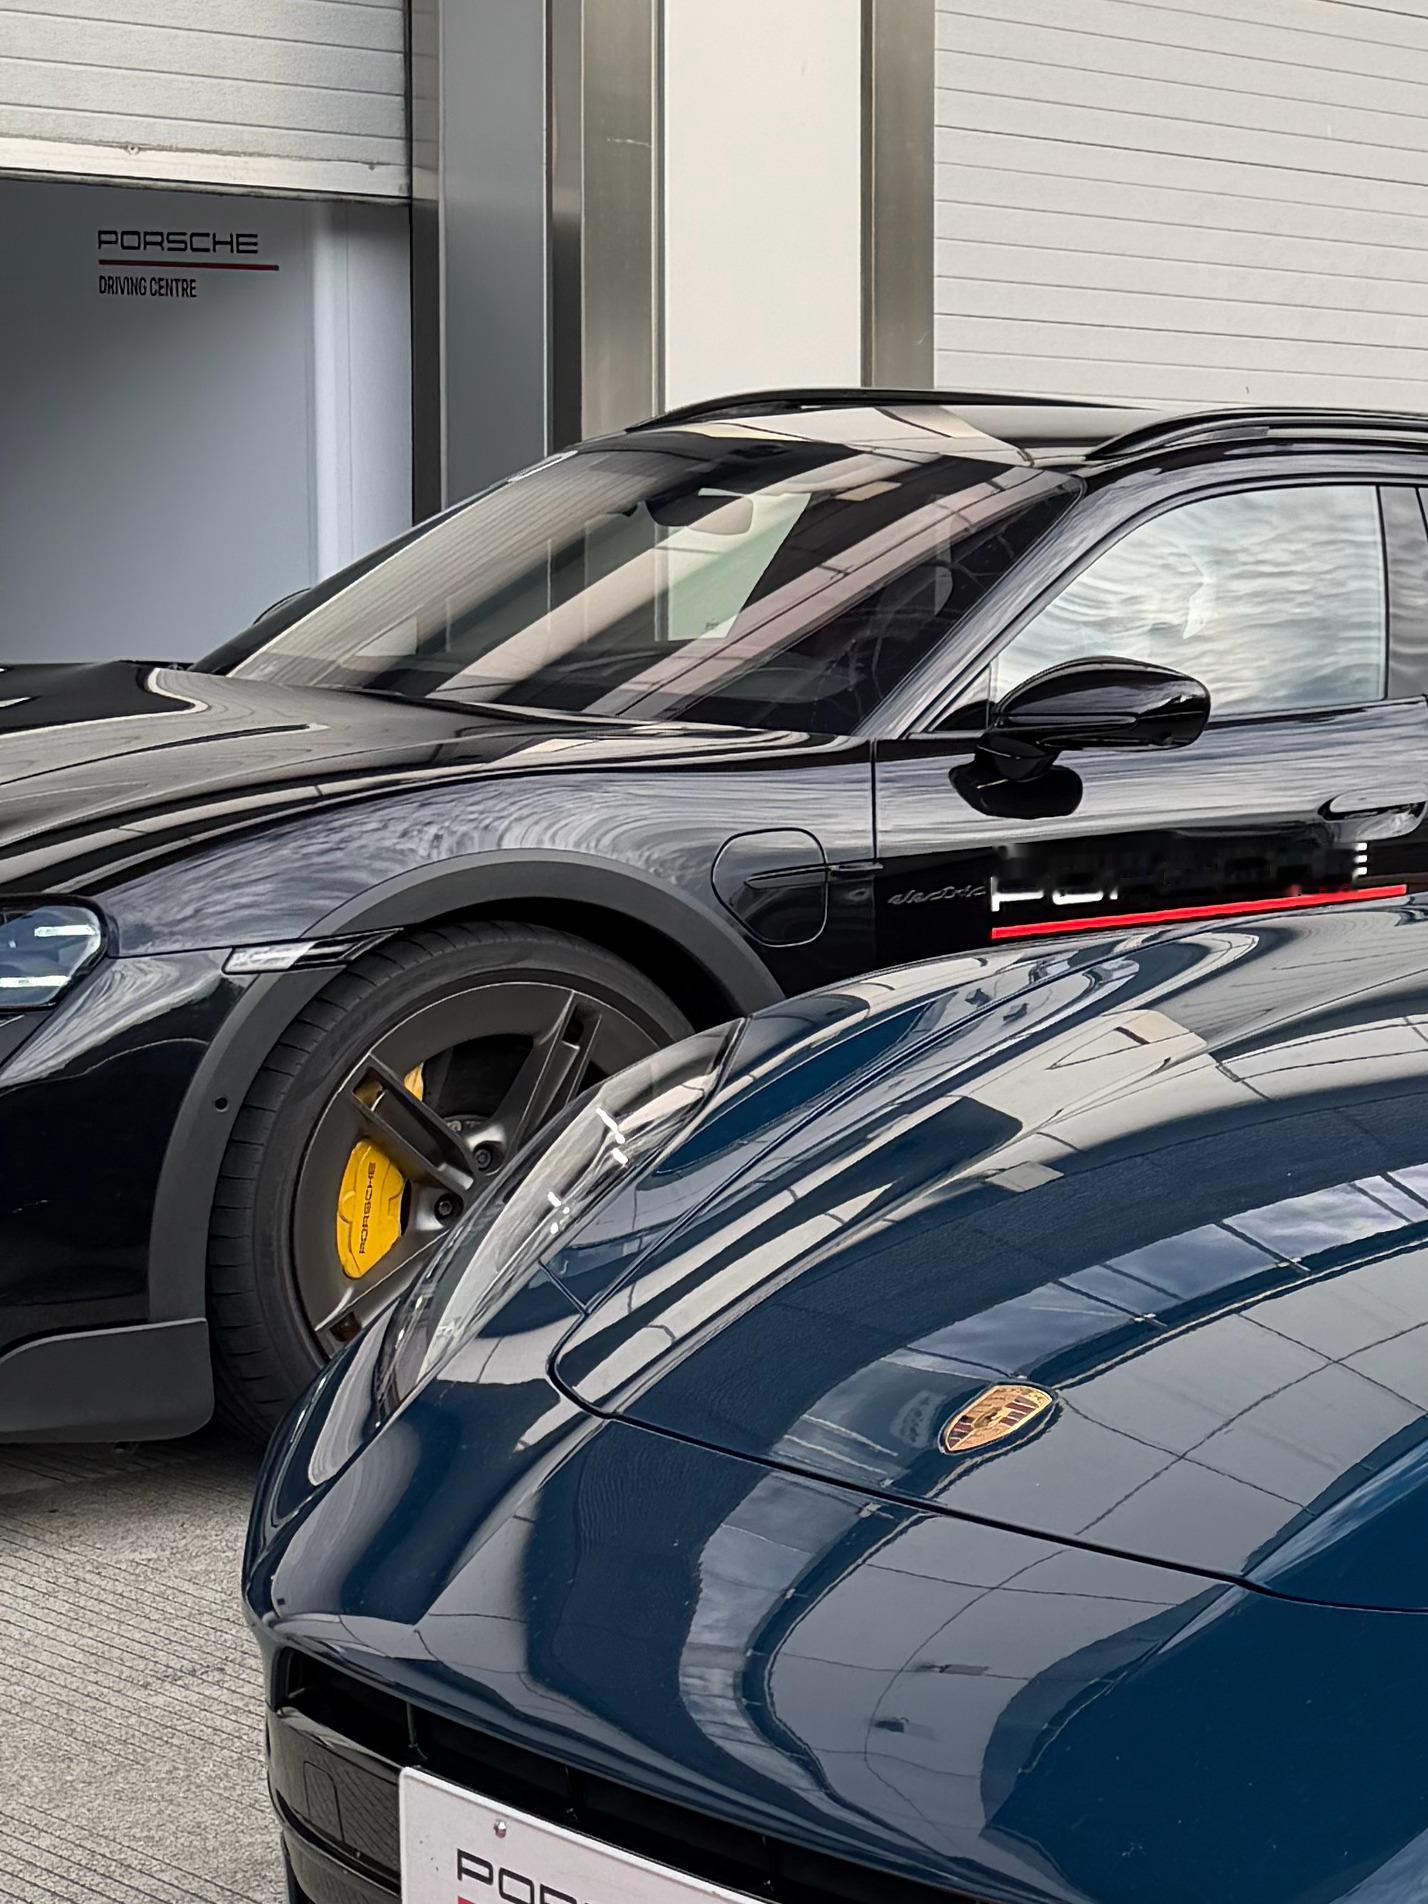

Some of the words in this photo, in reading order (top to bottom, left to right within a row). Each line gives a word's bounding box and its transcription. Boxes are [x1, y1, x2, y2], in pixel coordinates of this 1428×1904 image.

[97, 230, 259, 254] PORSCHE
[99, 275, 147, 296] DRIVING
[149, 277, 198, 298] CENTRE
